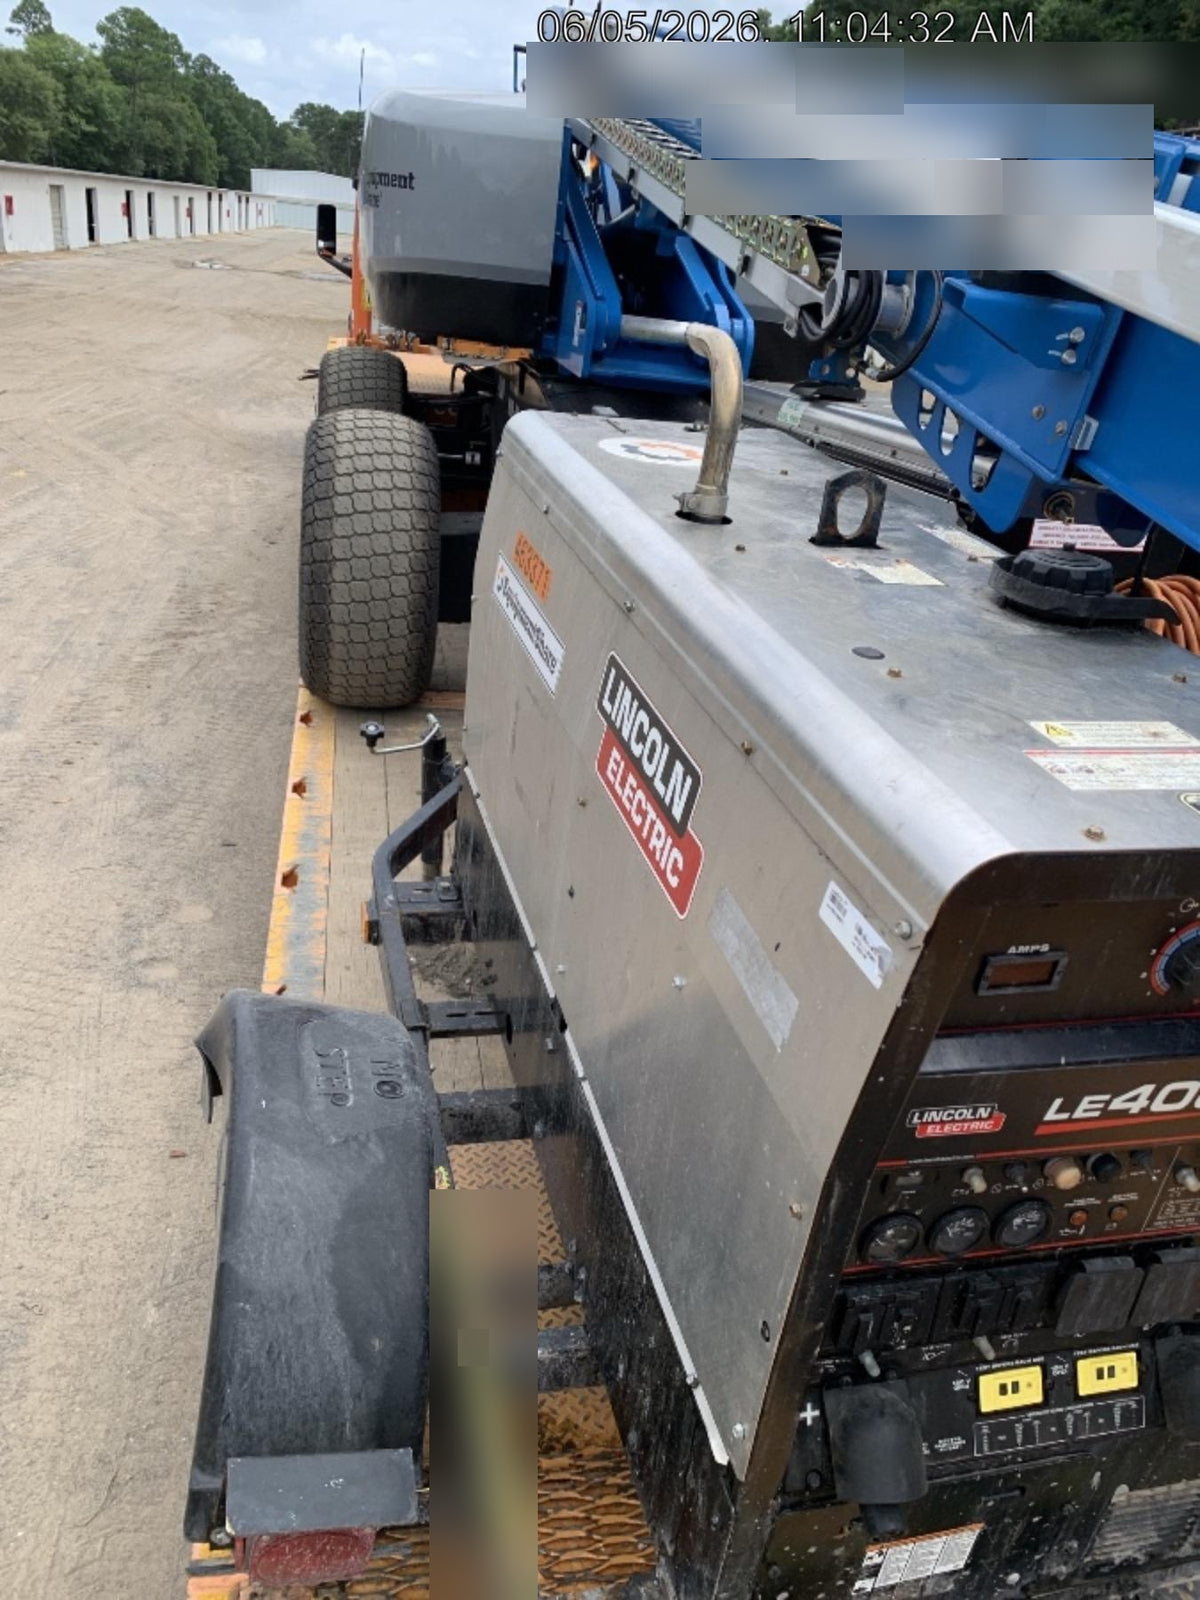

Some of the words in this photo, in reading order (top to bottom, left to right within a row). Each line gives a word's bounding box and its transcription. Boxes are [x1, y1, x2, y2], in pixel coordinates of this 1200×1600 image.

[368, 171, 416, 191] pment
[602, 667, 693, 824] LINCOLN
[606, 746, 684, 889] ELECTRIC
[1007, 943, 1050, 954] AMPS
[312, 1046, 354, 1108] STEP
[369, 1058, 406, 1100] NO
[911, 1107, 991, 1124] LINCOLN
[1042, 1080, 1200, 1121] LE40
[925, 1120, 995, 1134] ELECTRIC
